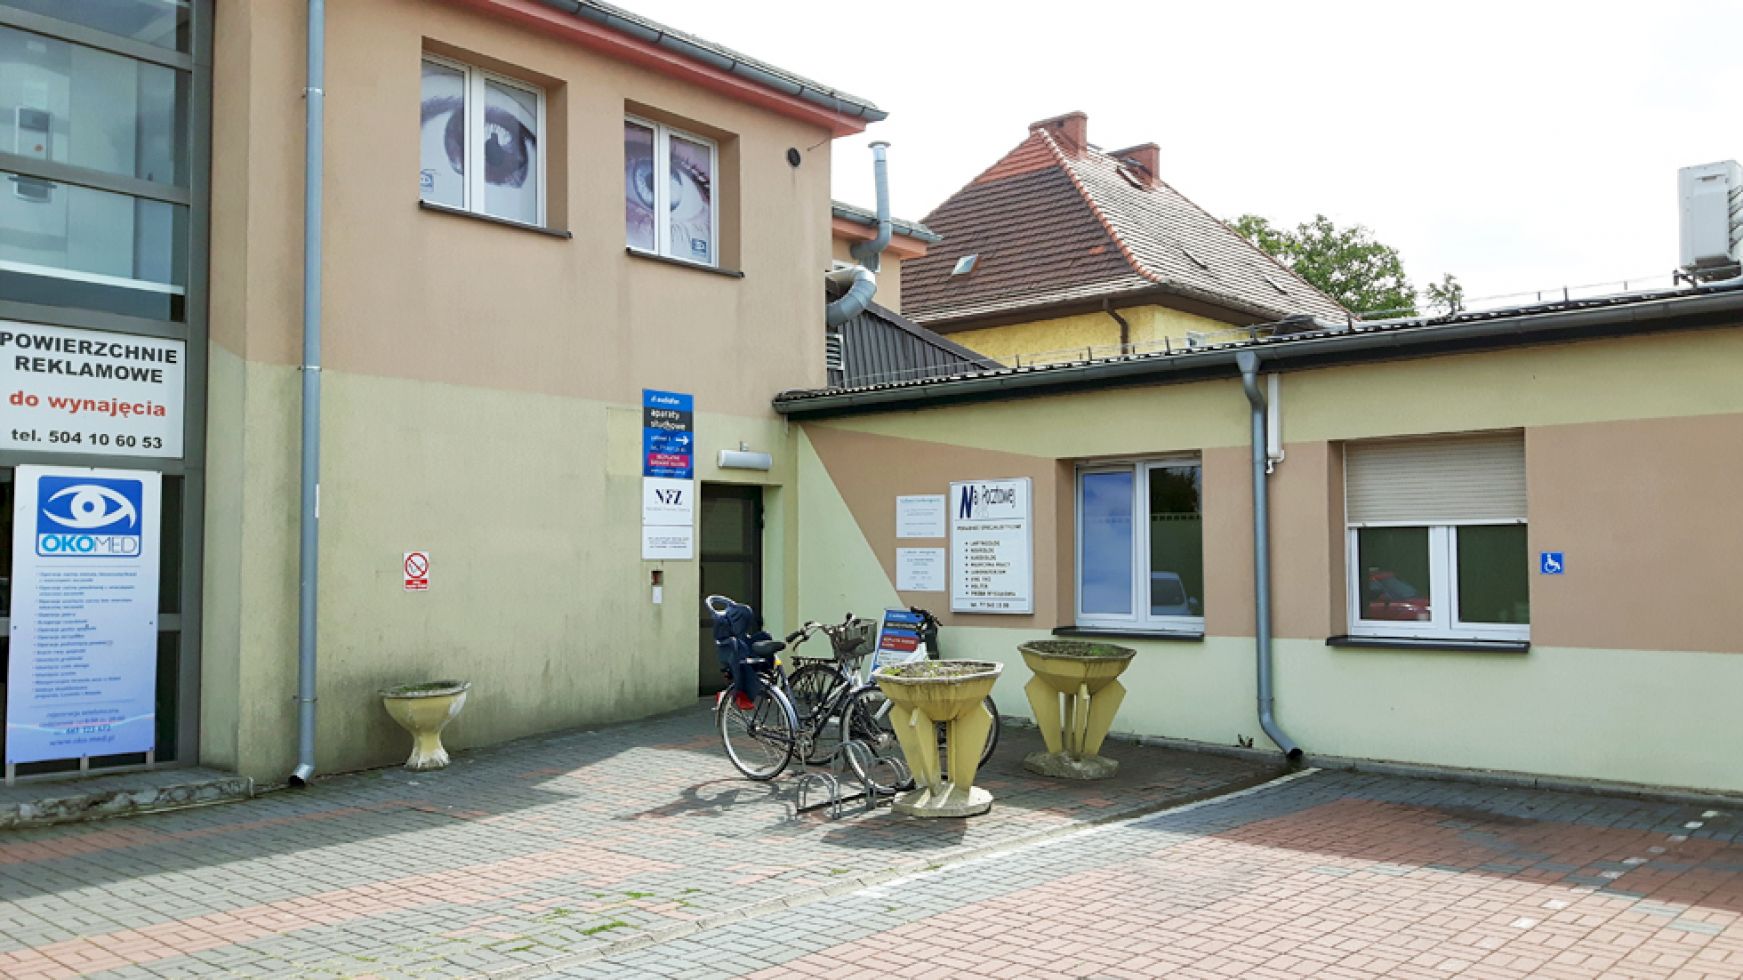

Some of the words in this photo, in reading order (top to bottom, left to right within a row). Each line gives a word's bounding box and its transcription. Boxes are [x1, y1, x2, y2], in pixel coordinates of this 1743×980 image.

[0, 332, 177, 364] POWIERZCHNIE
[15, 355, 163, 383] REKLAMOWE
[9, 390, 39, 407] do
[48, 396, 166, 418] wynajęcia
[11, 428, 42, 442] tel.
[49, 430, 82, 444] 504
[89, 433, 109, 446] 10
[115, 435, 136, 448] 60
[142, 437, 163, 449] 53
[655, 488, 683, 506] NFZ
[960, 485, 978, 518] Na
[41, 534, 137, 554] OKOMED
